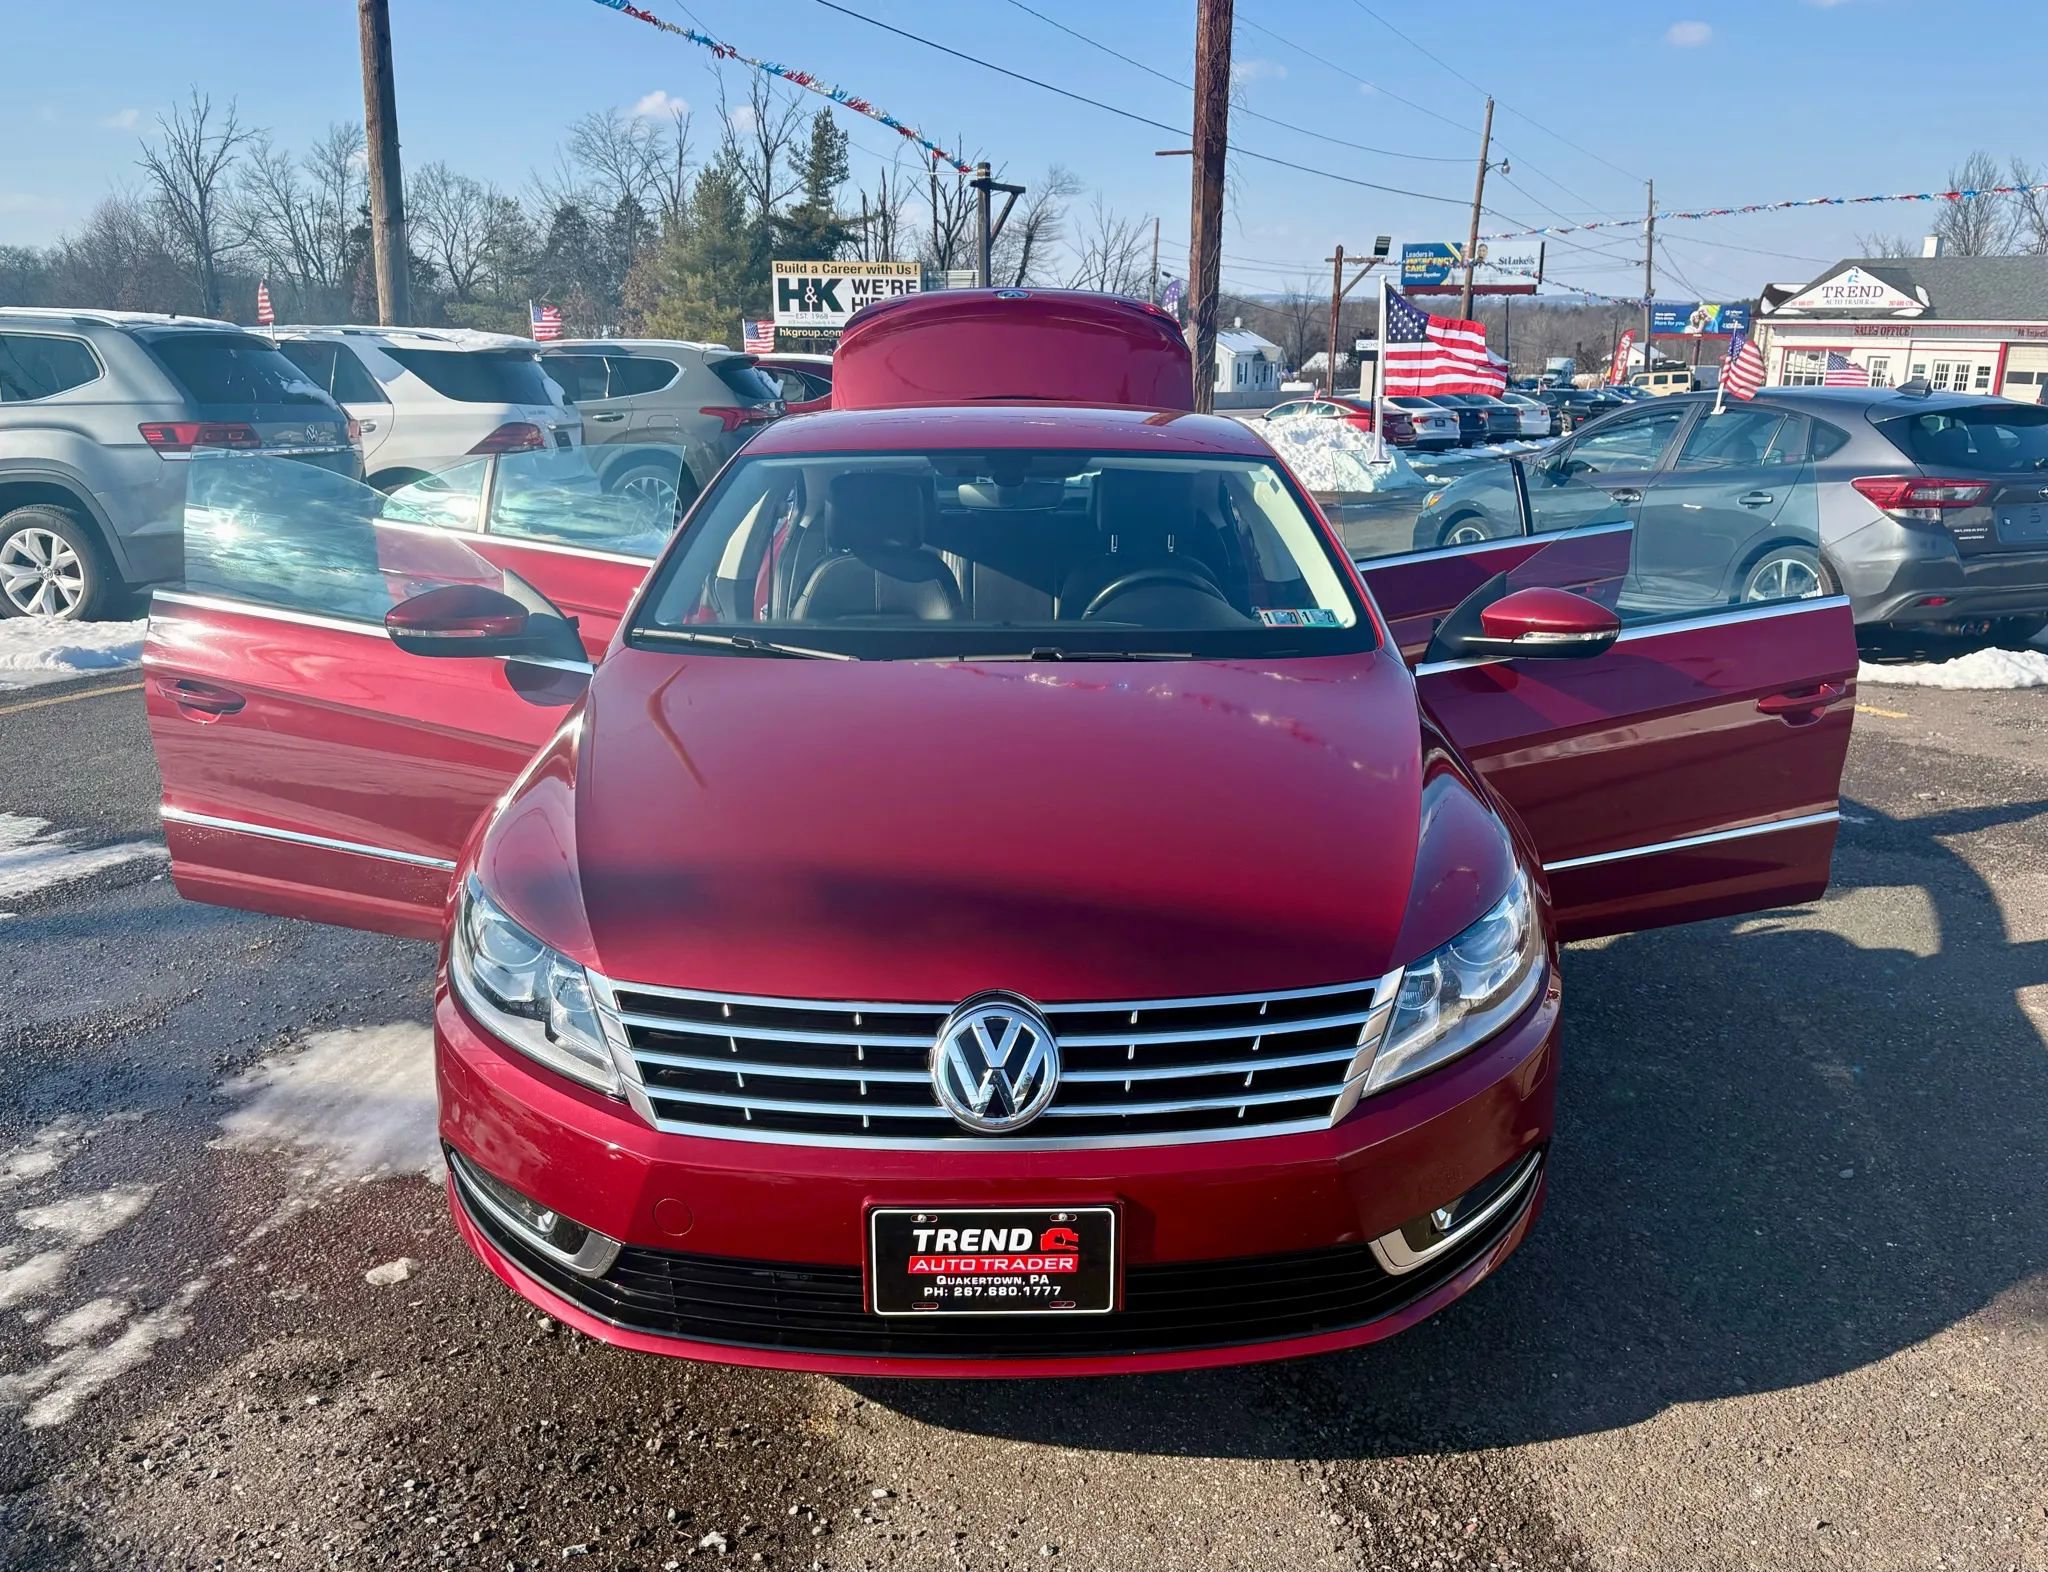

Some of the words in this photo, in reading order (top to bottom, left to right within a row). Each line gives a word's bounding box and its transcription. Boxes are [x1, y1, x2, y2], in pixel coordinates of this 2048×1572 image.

[776, 263, 807, 274] Build
[811, 265, 818, 273] a
[822, 263, 862, 274] Career
[866, 264, 893, 275] with
[852, 279, 917, 295] WE'RE
[1821, 285, 1885, 298] TREND
[778, 278, 845, 312] H&K
[779, 328, 843, 338] hkgroup.com
[1854, 325, 1878, 336] SALES
[1880, 326, 1910, 336] OFFICE
[912, 1228, 1033, 1252] TREND
[912, 1259, 976, 1272] AUTO
[980, 1257, 1074, 1271] TRADER
[1030, 1275, 1049, 1285] PA
[924, 1286, 948, 1297] PH:
[953, 1285, 1062, 1297] 267.680.1777
